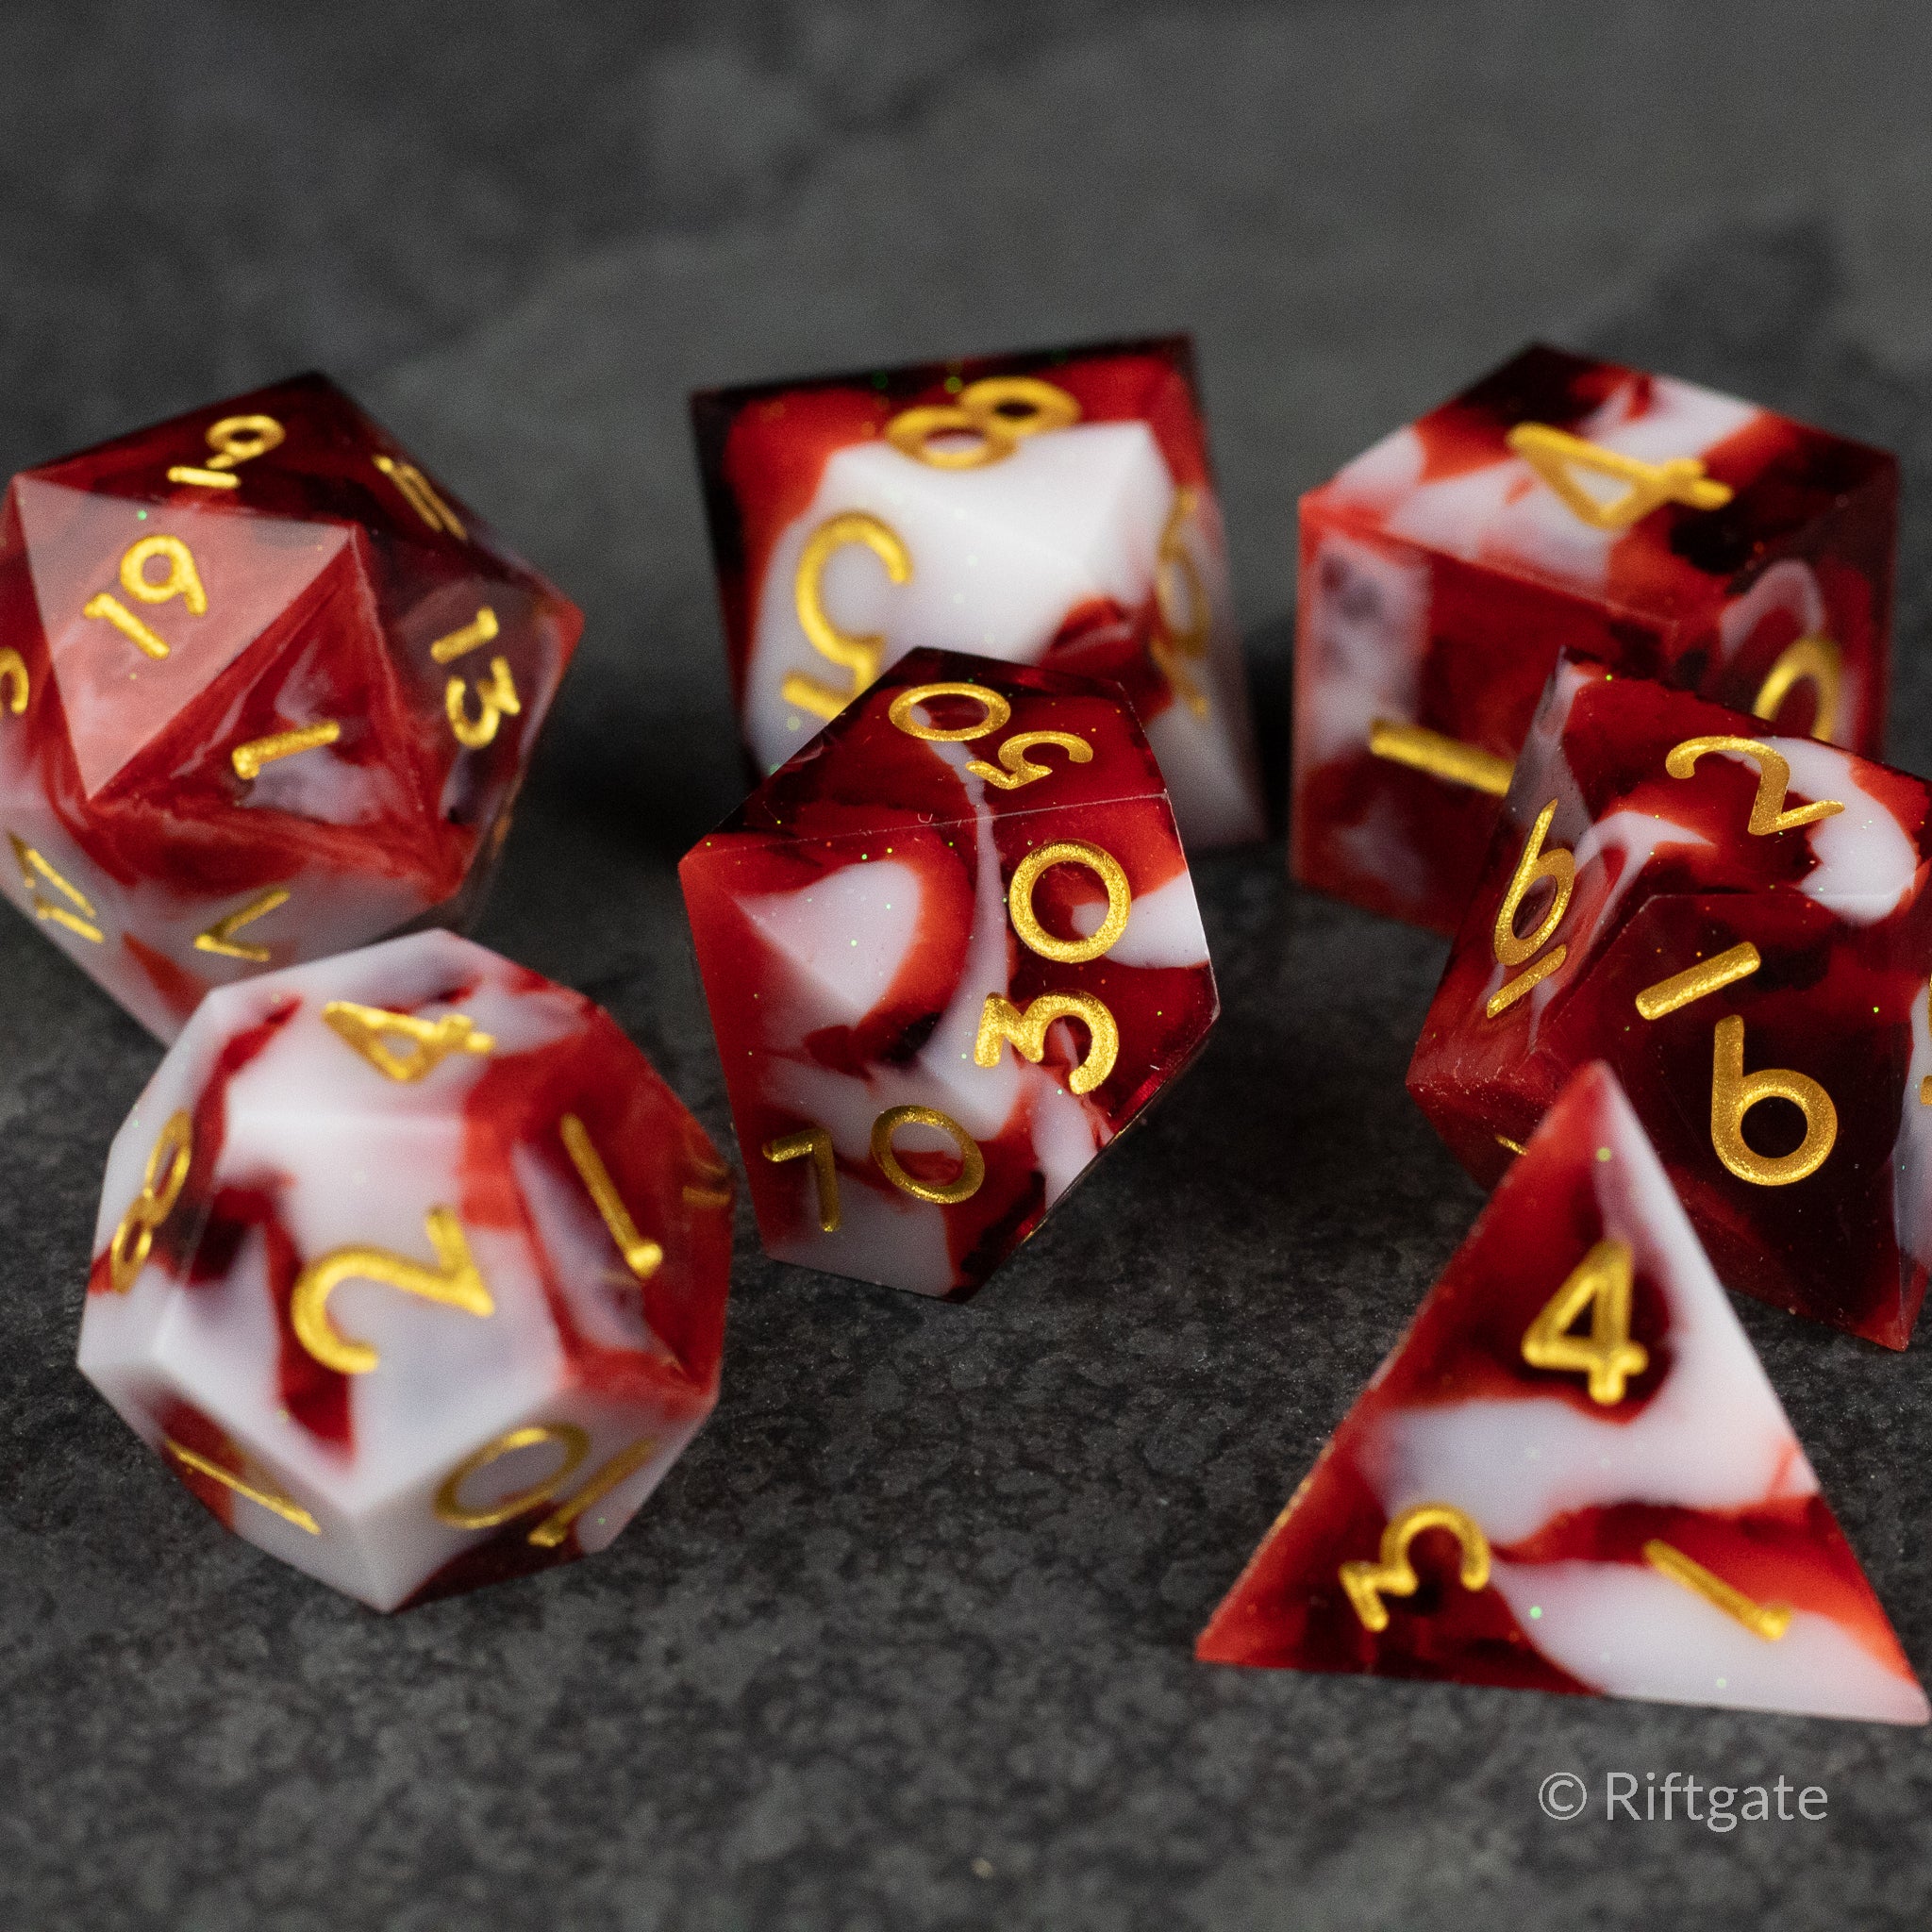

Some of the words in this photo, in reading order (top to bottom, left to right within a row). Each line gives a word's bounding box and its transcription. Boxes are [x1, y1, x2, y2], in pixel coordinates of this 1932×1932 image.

[885, 376, 1081, 470] 8
[1507, 422, 1734, 530] 4
[85, 534, 208, 659] 19
[777, 508, 913, 724] 5
[432, 607, 522, 748] 13
[889, 683, 1094, 791] 50
[232, 720, 341, 781] 1
[1665, 736, 1846, 837] 2
[974, 837, 1133, 1095] 30
[322, 1002, 496, 1083] 4
[110, 1109, 193, 1294] 8
[762, 1105, 985, 1233] 70
[291, 1205, 496, 1376] 2
[1522, 1241, 1650, 1405] 4
[1338, 1505, 1491, 1633] 3
[1643, 1538, 1794, 1642] 1
